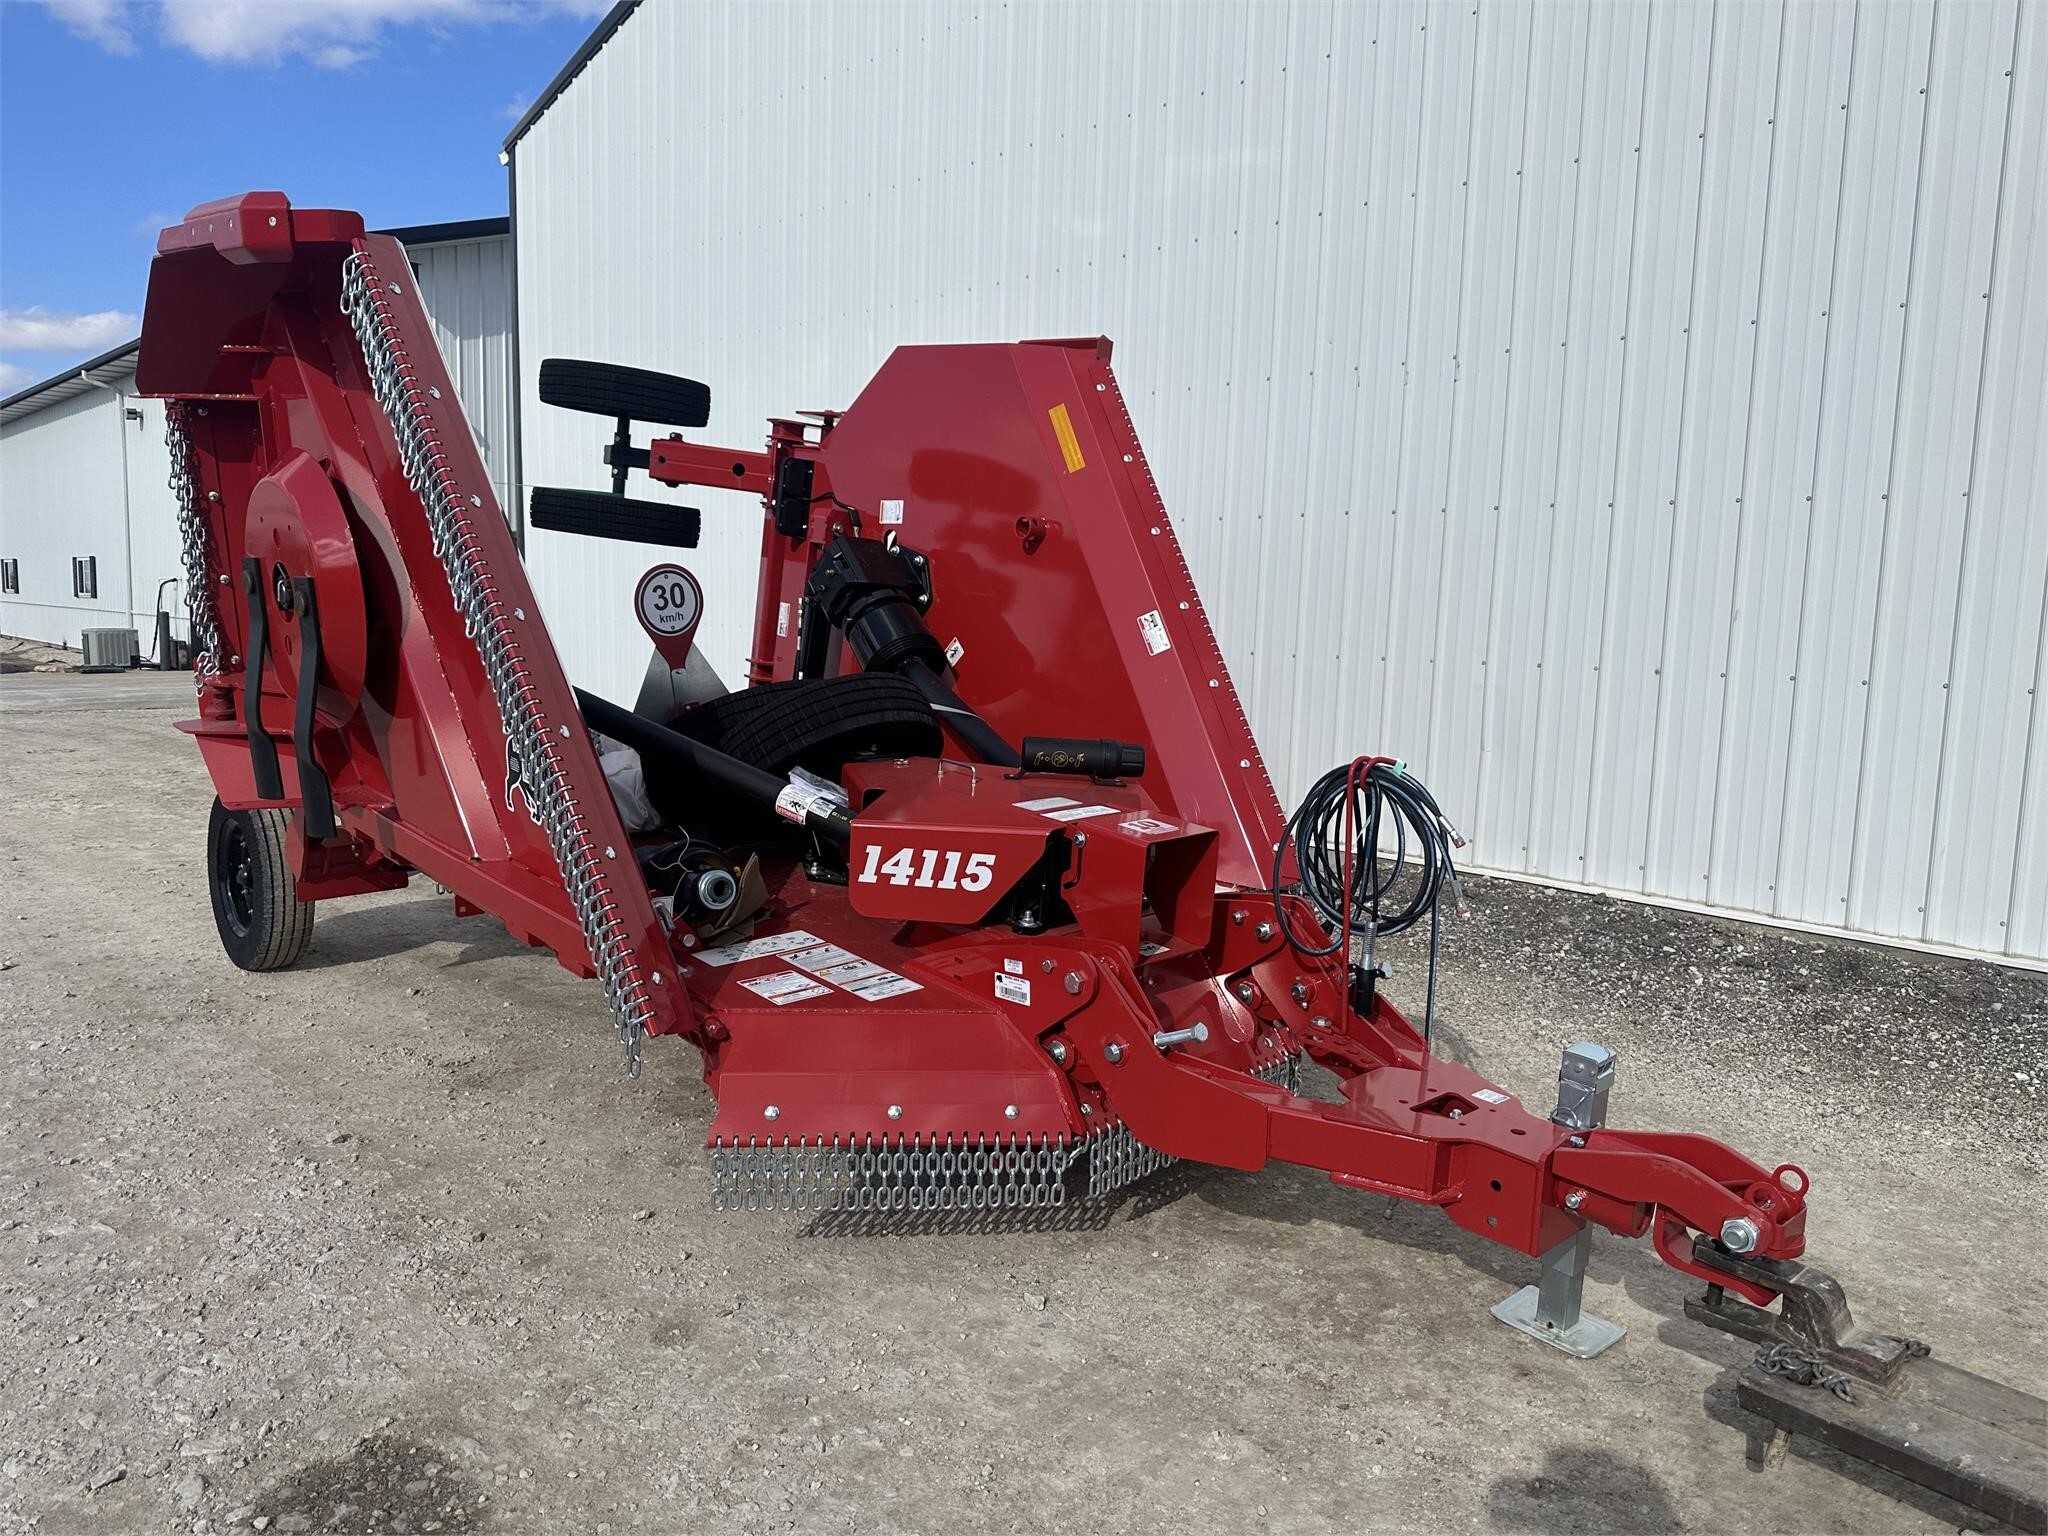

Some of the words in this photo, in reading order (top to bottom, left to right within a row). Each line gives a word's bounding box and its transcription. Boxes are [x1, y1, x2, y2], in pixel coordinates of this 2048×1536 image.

[652, 582, 686, 611] 30
[658, 612, 685, 624] km/h
[857, 845, 997, 892] 14115
